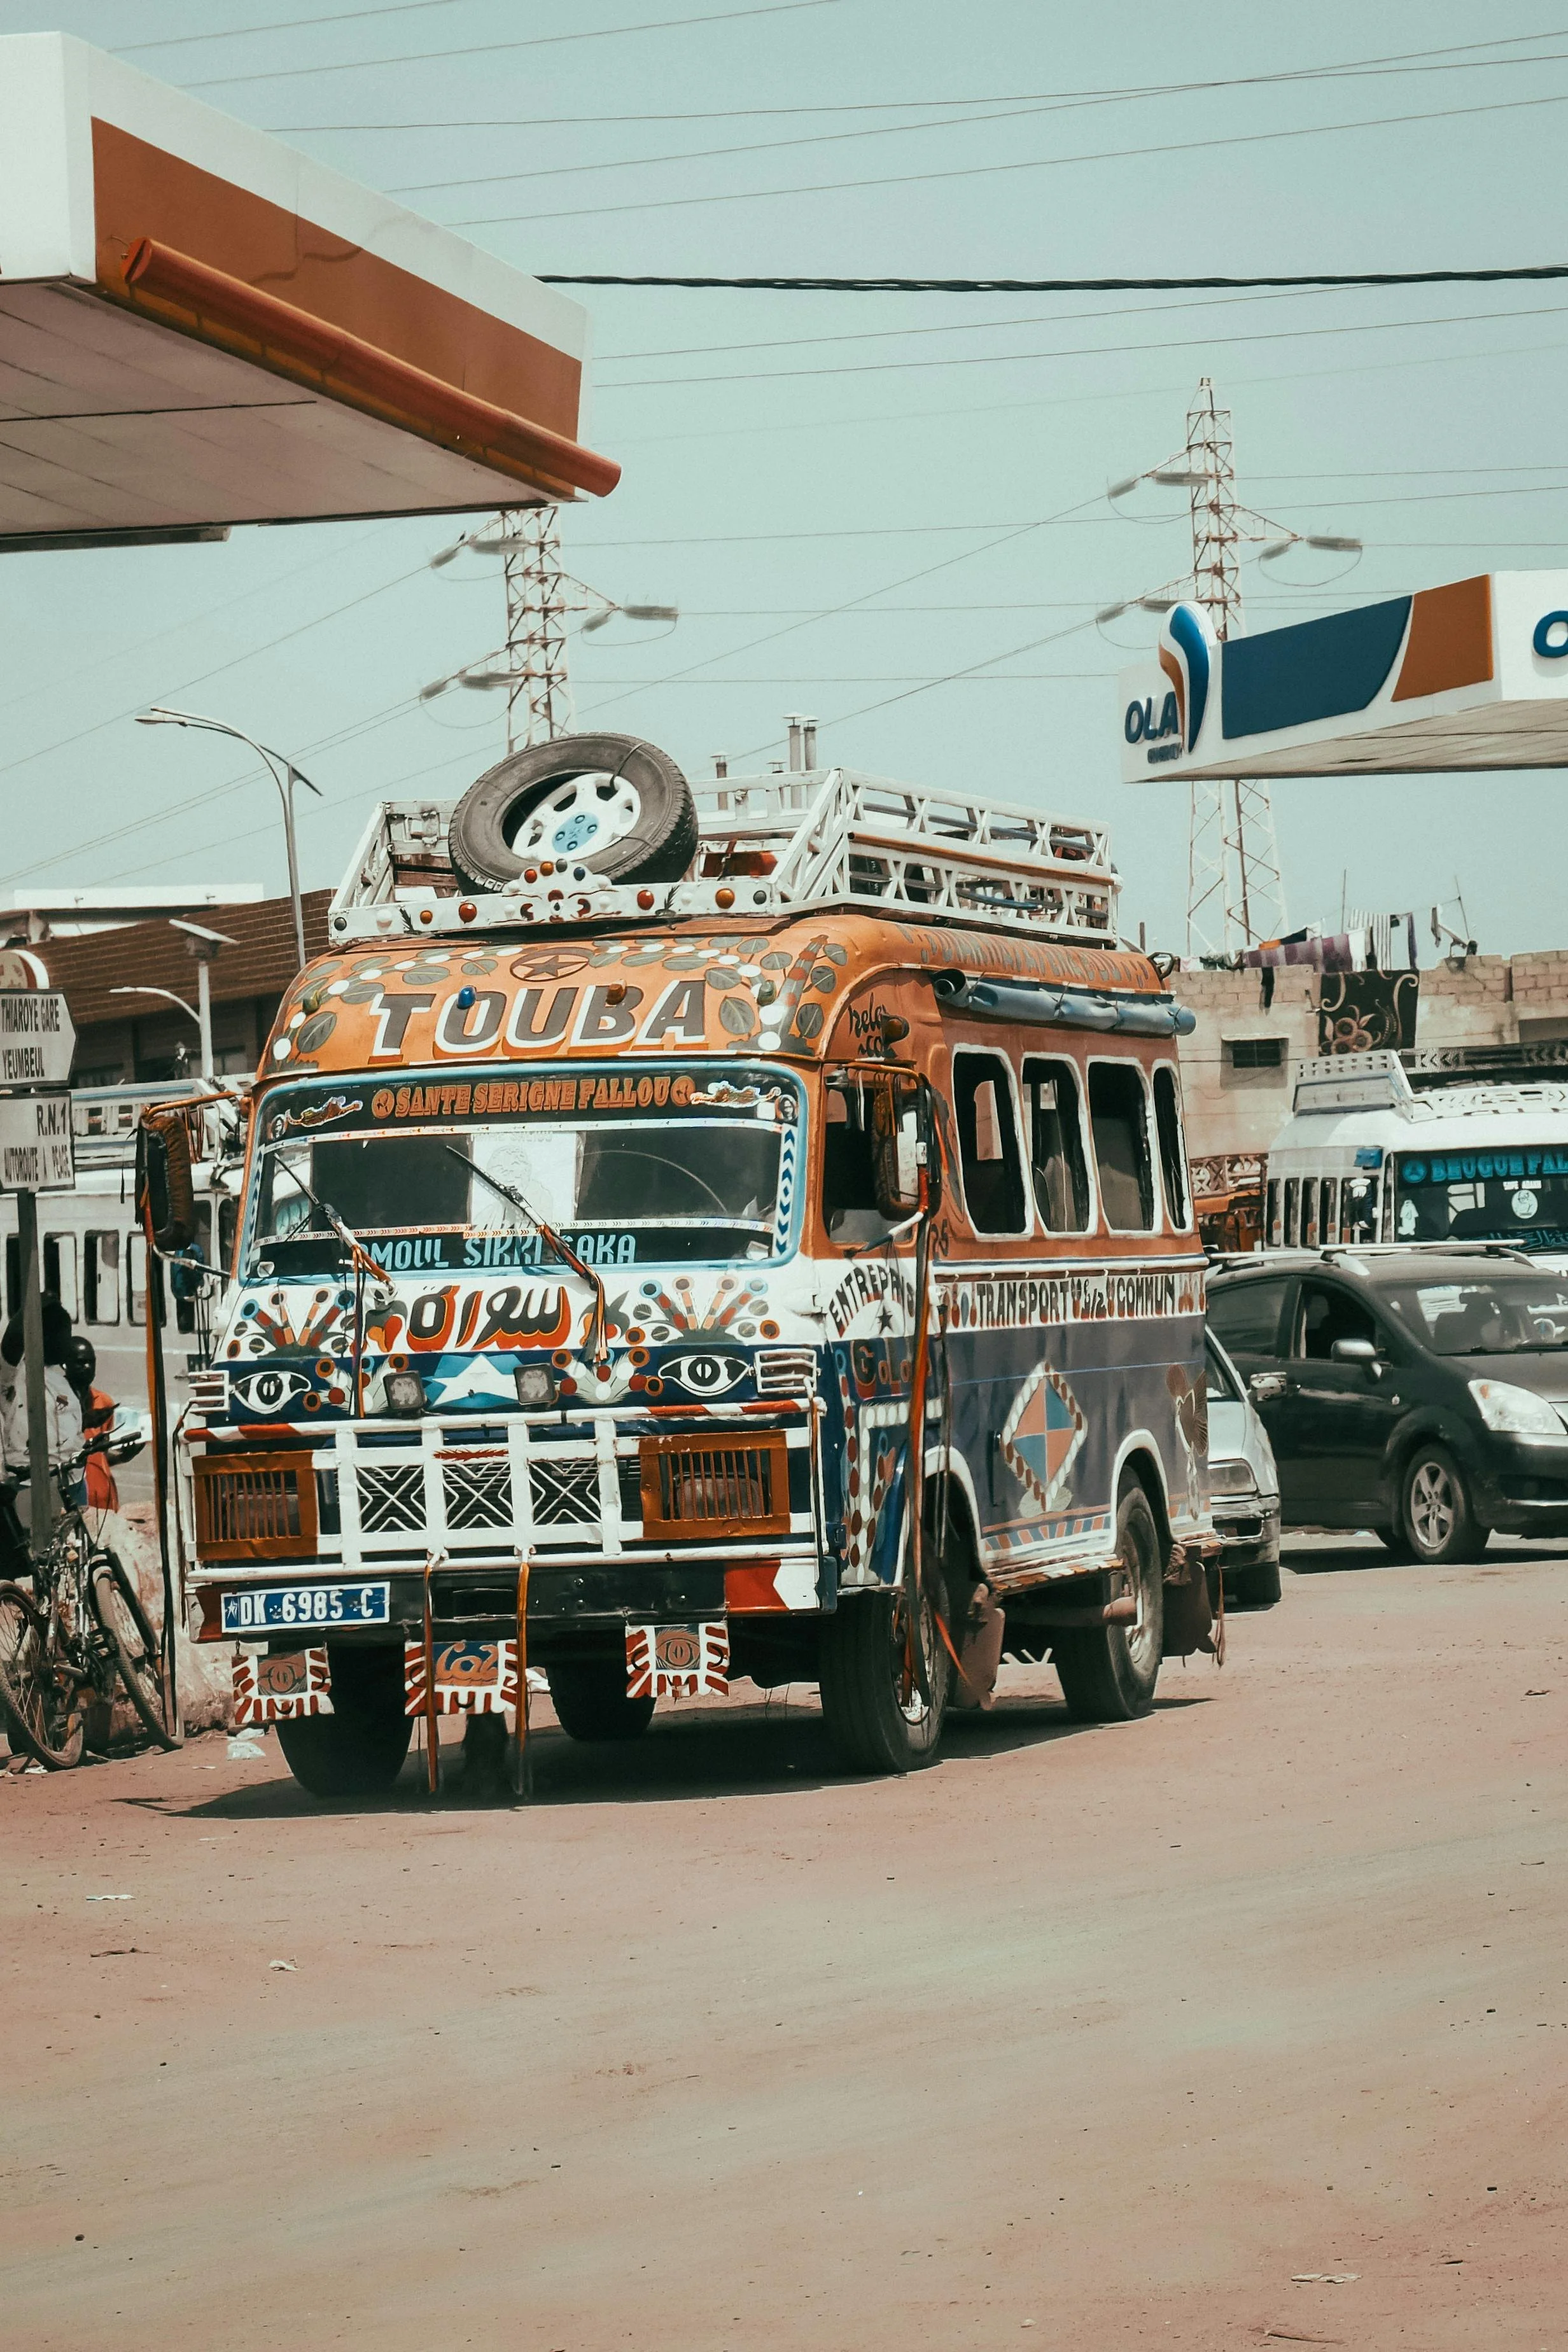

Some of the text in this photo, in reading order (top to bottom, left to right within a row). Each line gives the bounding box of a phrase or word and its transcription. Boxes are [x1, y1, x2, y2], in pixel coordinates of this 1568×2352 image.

[1124, 691, 1179, 743] OLA
[1, 998, 60, 1032] THIAROYE GARE
[368, 980, 709, 1063] TOUBA
[3, 1047, 45, 1079] YEUMBEUL
[395, 1077, 671, 1117] SANTE SERIGNE FALLOU
[36, 1103, 66, 1136] R.N.1
[977, 1280, 1070, 1329] TRANSPORT
[1117, 1275, 1177, 1318] COMMUN
[239, 1588, 374, 1625] DK 6985 C
